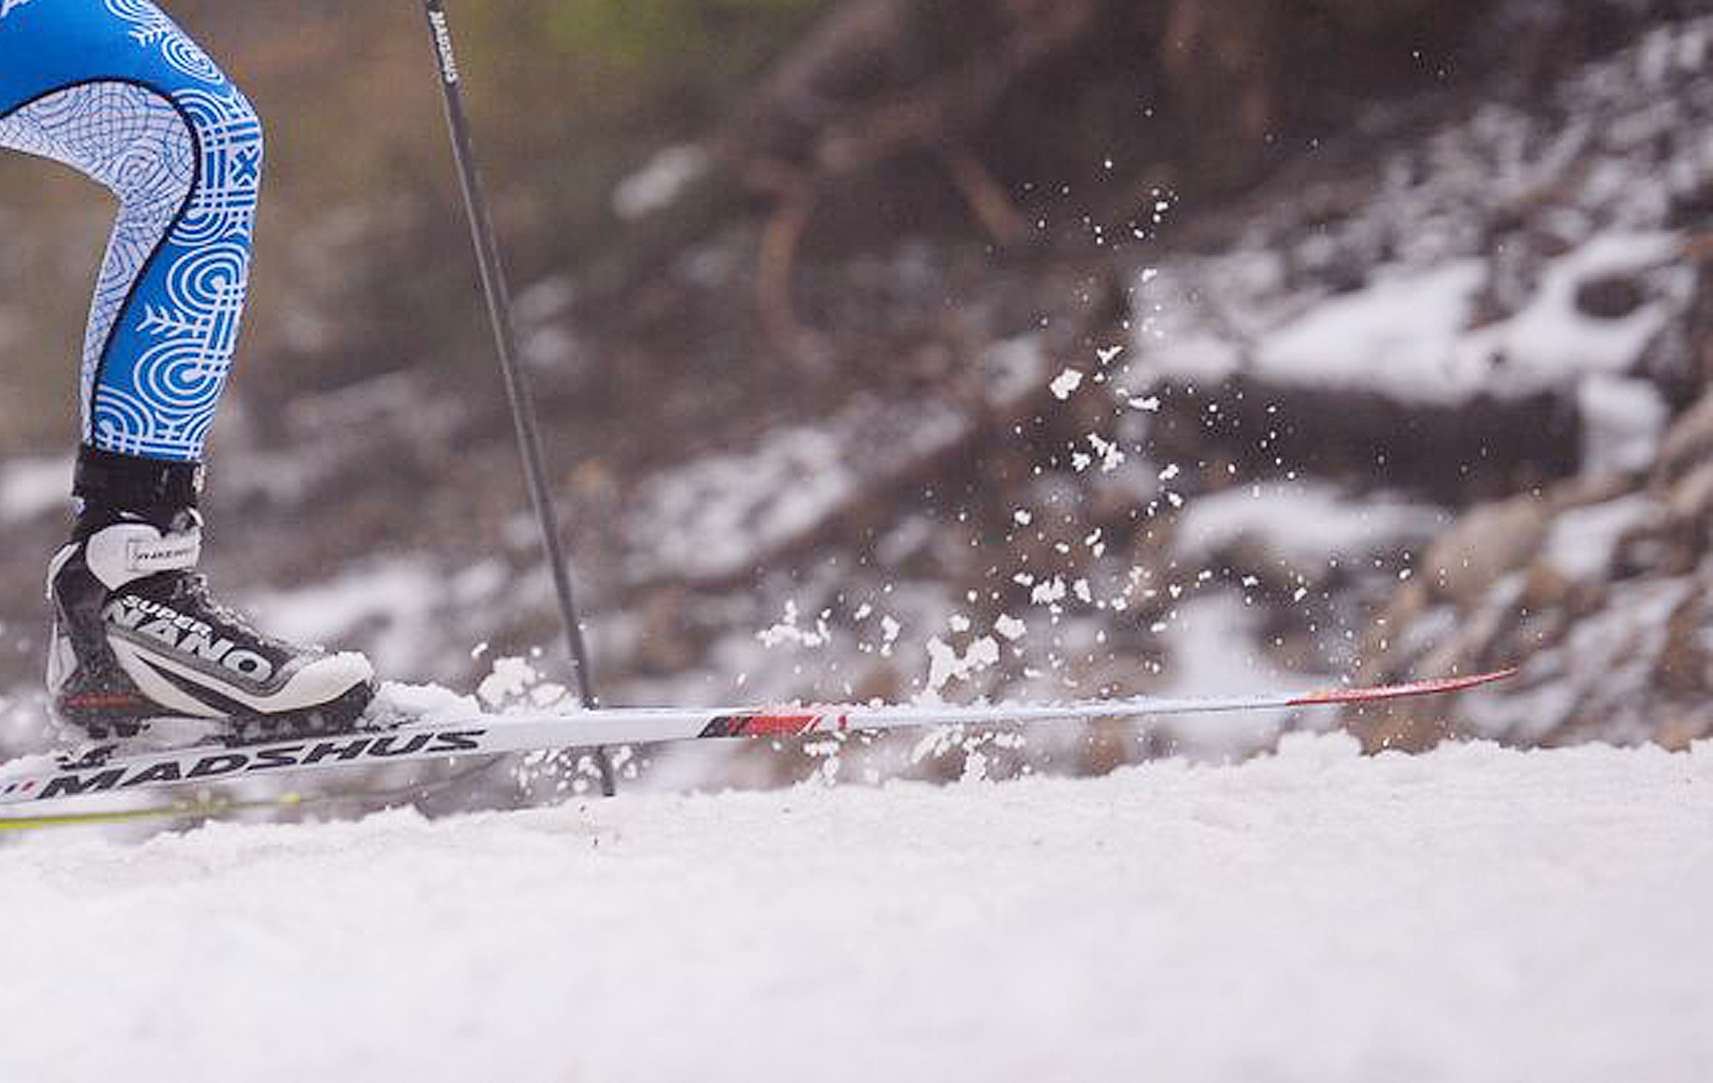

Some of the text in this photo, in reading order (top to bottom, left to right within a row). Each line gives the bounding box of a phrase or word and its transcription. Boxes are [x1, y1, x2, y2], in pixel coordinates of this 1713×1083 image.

[103, 598, 273, 683] NANO
[122, 594, 214, 637] SUPER
[36, 728, 488, 800] MADSHUS
